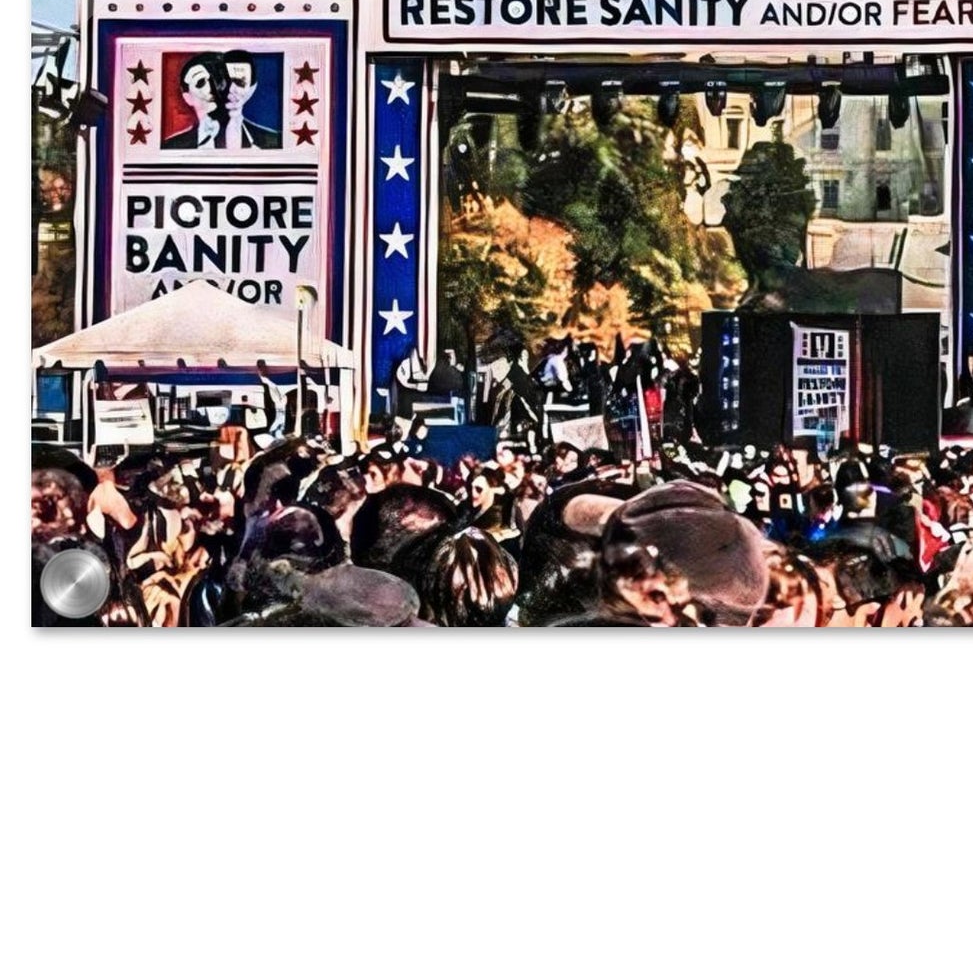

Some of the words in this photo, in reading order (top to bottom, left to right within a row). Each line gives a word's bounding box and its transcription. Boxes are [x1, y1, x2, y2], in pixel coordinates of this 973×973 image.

[760, 2, 882, 26] AND/OR
[126, 195, 314, 229] PICTORE
[126, 234, 310, 274] BANITY
[151, 279, 283, 305] A/OR
